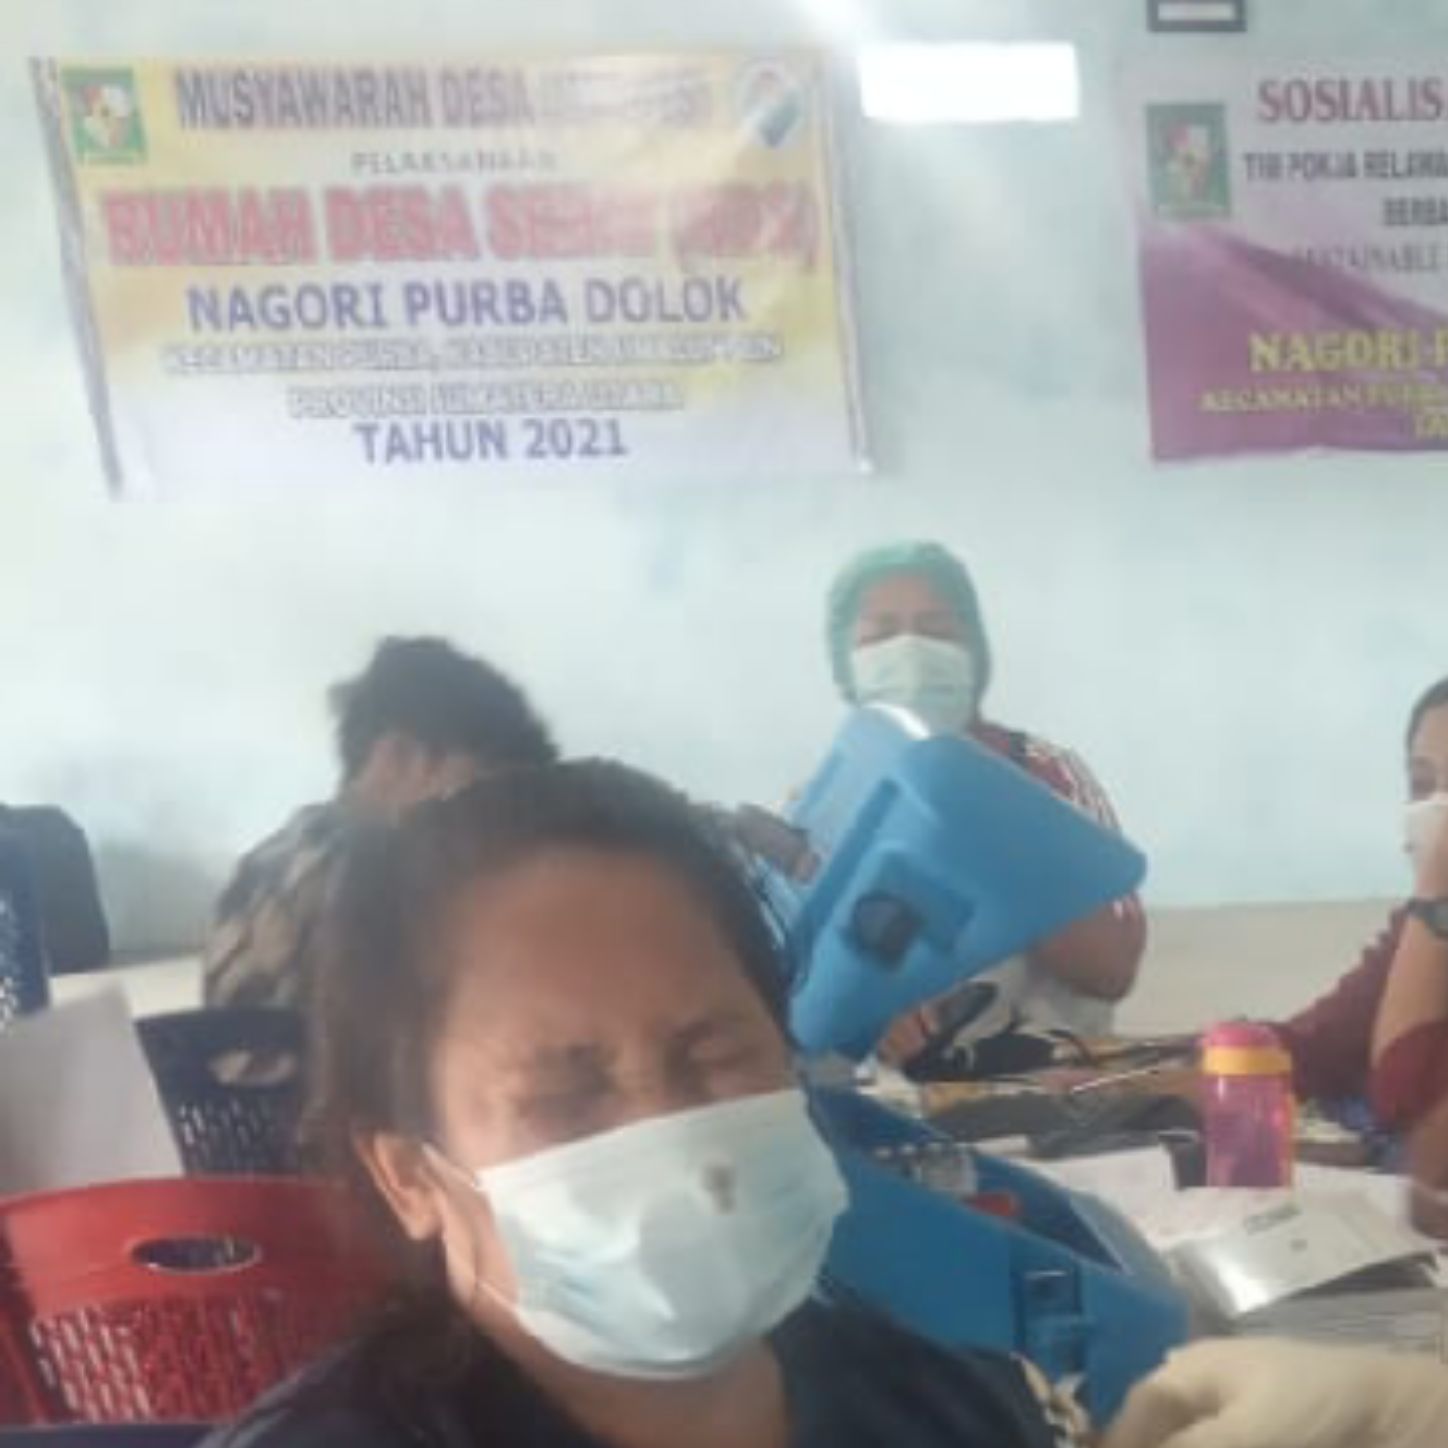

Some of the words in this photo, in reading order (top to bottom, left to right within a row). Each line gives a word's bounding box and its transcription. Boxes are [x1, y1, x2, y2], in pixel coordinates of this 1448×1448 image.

[174, 66, 433, 128] MUSYAWARAH
[440, 64, 537, 127] DESA
[1287, 151, 1356, 181] POKJA
[324, 180, 481, 263] DESA
[187, 282, 389, 333] NAGORI
[402, 277, 569, 329] PURBA
[583, 274, 747, 324] DOLOK
[1249, 327, 1419, 373] NAGORI
[352, 418, 508, 465] TAHUN
[522, 416, 632, 460] 2021
